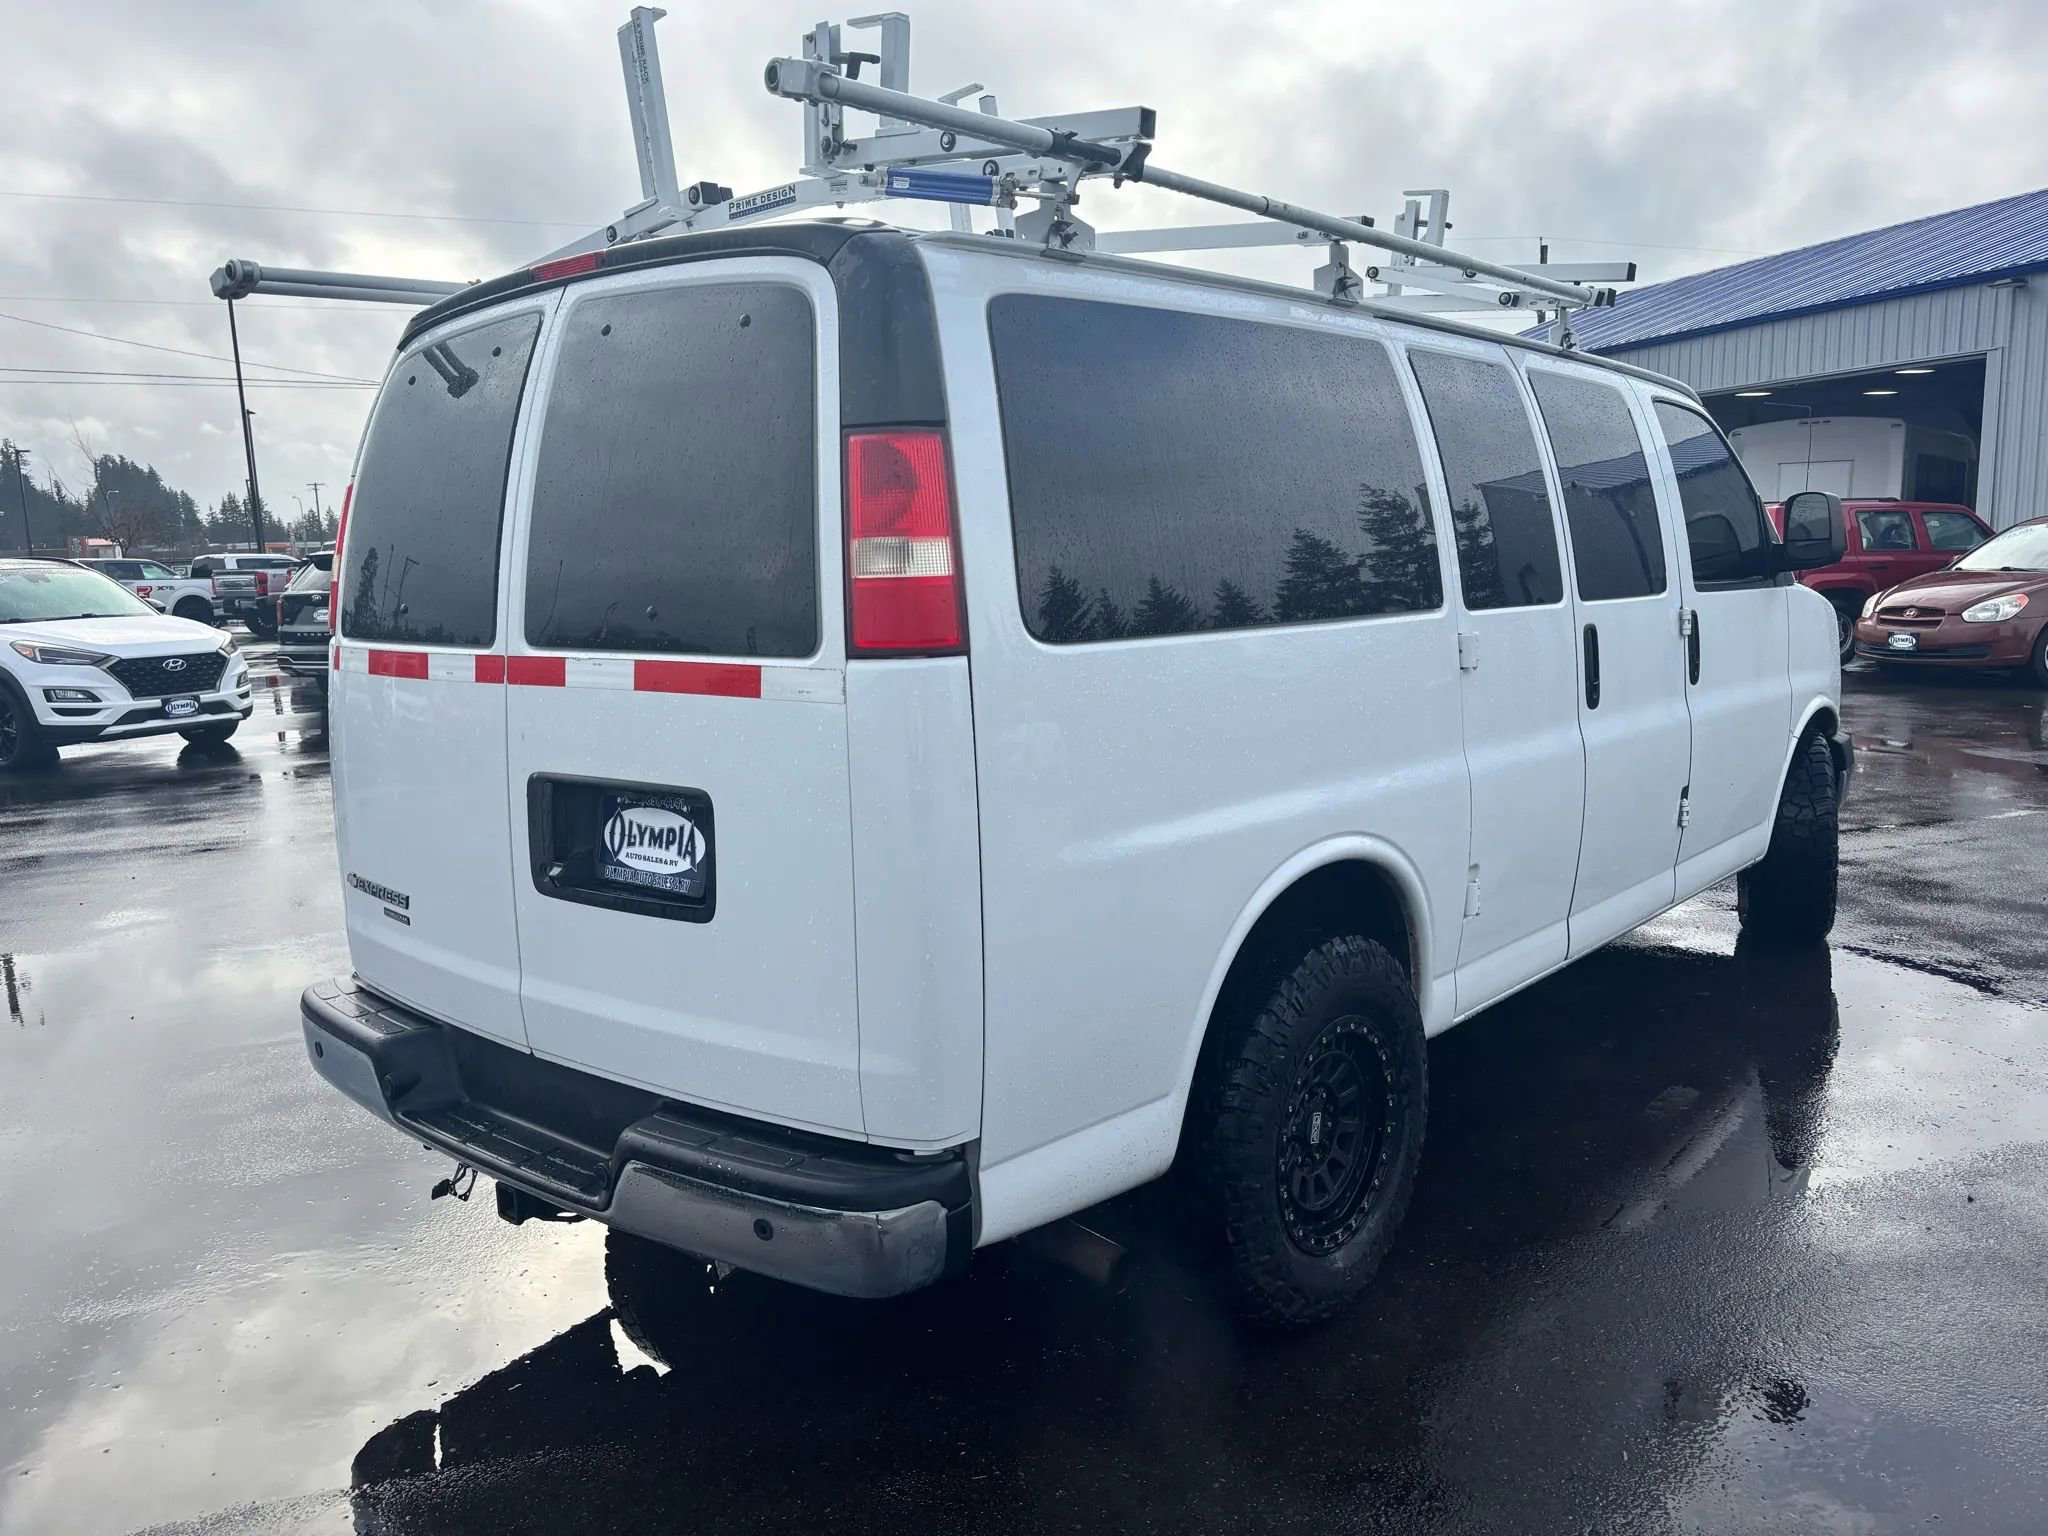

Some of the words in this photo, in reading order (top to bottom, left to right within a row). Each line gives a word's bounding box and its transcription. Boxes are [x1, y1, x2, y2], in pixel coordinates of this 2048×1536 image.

[729, 198, 757, 212] PRIME
[760, 184, 796, 204] DESIGN
[167, 701, 198, 713] OLYMPIA
[609, 807, 698, 873] OLYMPIA
[625, 852, 643, 861] AUTO
[642, 856, 663, 865] SALES
[605, 865, 634, 883] OLYMPIA
[633, 870, 653, 887] AUTO
[653, 873, 673, 890] SALES
[358, 876, 409, 910] EXPRESS
